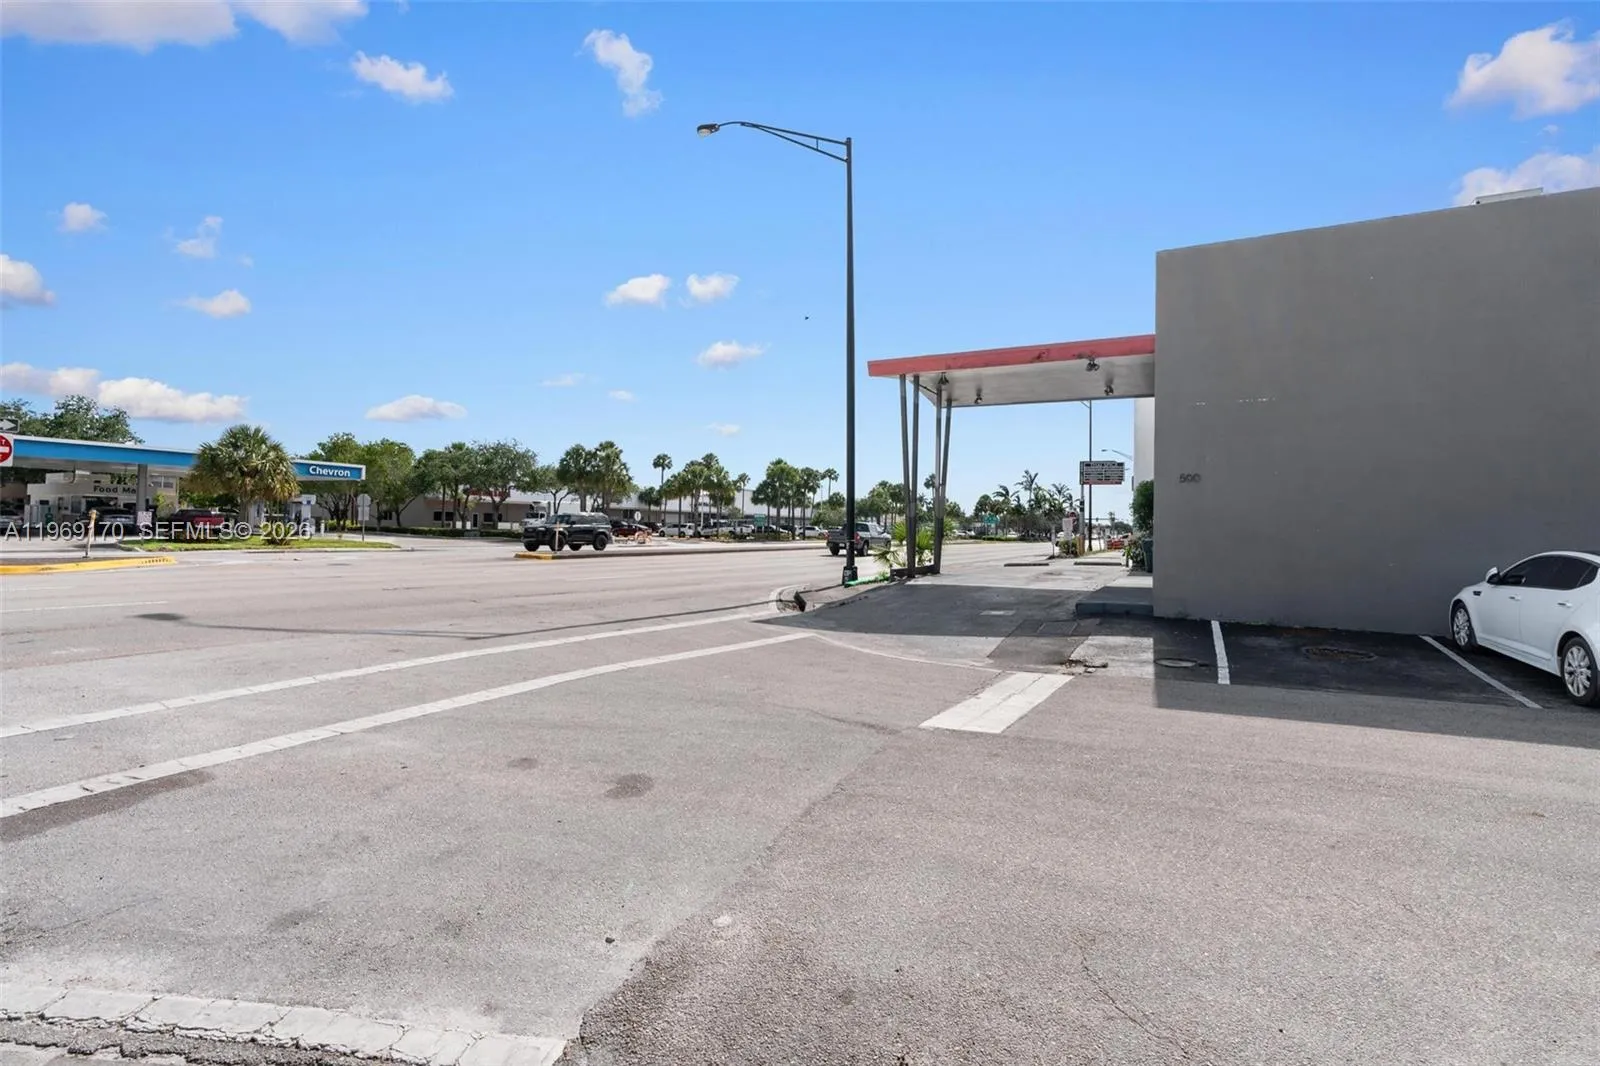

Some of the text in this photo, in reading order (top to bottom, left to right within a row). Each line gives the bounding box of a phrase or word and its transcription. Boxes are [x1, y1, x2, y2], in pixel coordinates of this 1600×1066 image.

[309, 465, 351, 477] Chevron
[1179, 473, 1201, 484] 500
[93, 485, 118, 493] Food
